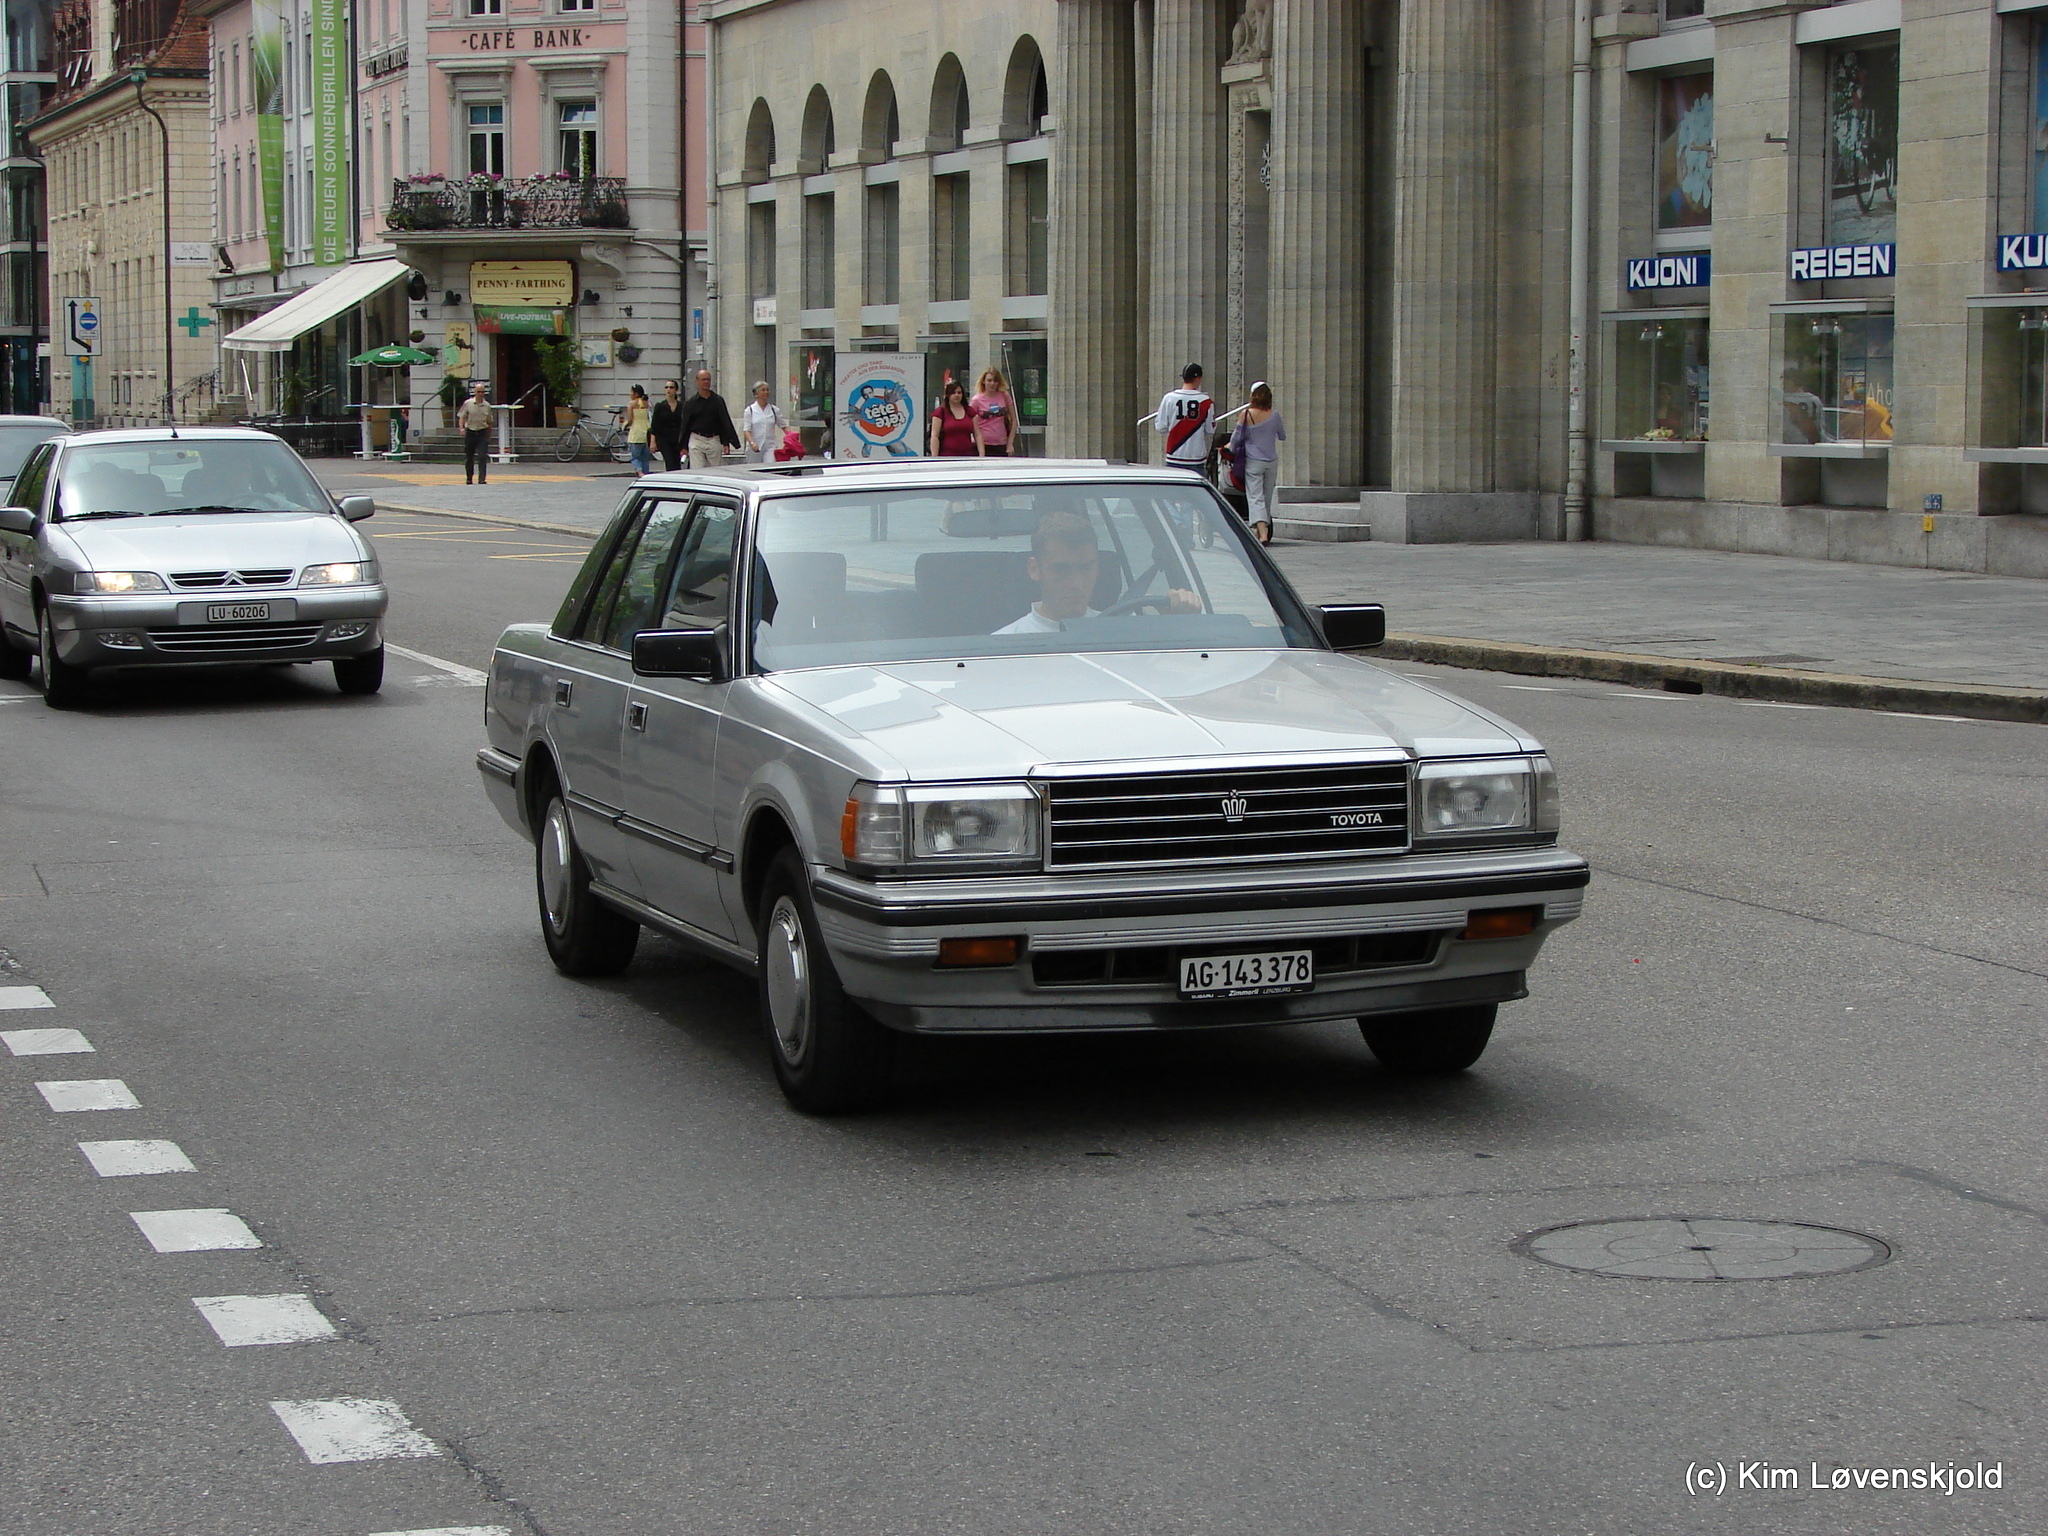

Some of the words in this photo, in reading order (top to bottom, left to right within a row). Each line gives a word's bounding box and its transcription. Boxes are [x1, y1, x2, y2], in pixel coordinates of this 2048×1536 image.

[469, 29, 515, 50] CAFÉ
[534, 29, 582, 48] BANK
[321, 36, 337, 173] SONNENBRILLEN
[322, 177, 337, 233] NEUEN
[323, 236, 337, 264] DIE
[1791, 245, 1891, 280] REISEN
[2002, 235, 2048, 268] KU
[477, 279, 509, 289] PENNY
[515, 279, 566, 288] FARTHING
[1629, 257, 1698, 288] KUONI
[865, 403, 895, 420] tête
[1176, 399, 1199, 420] 18
[1330, 813, 1383, 826] TOYOTA
